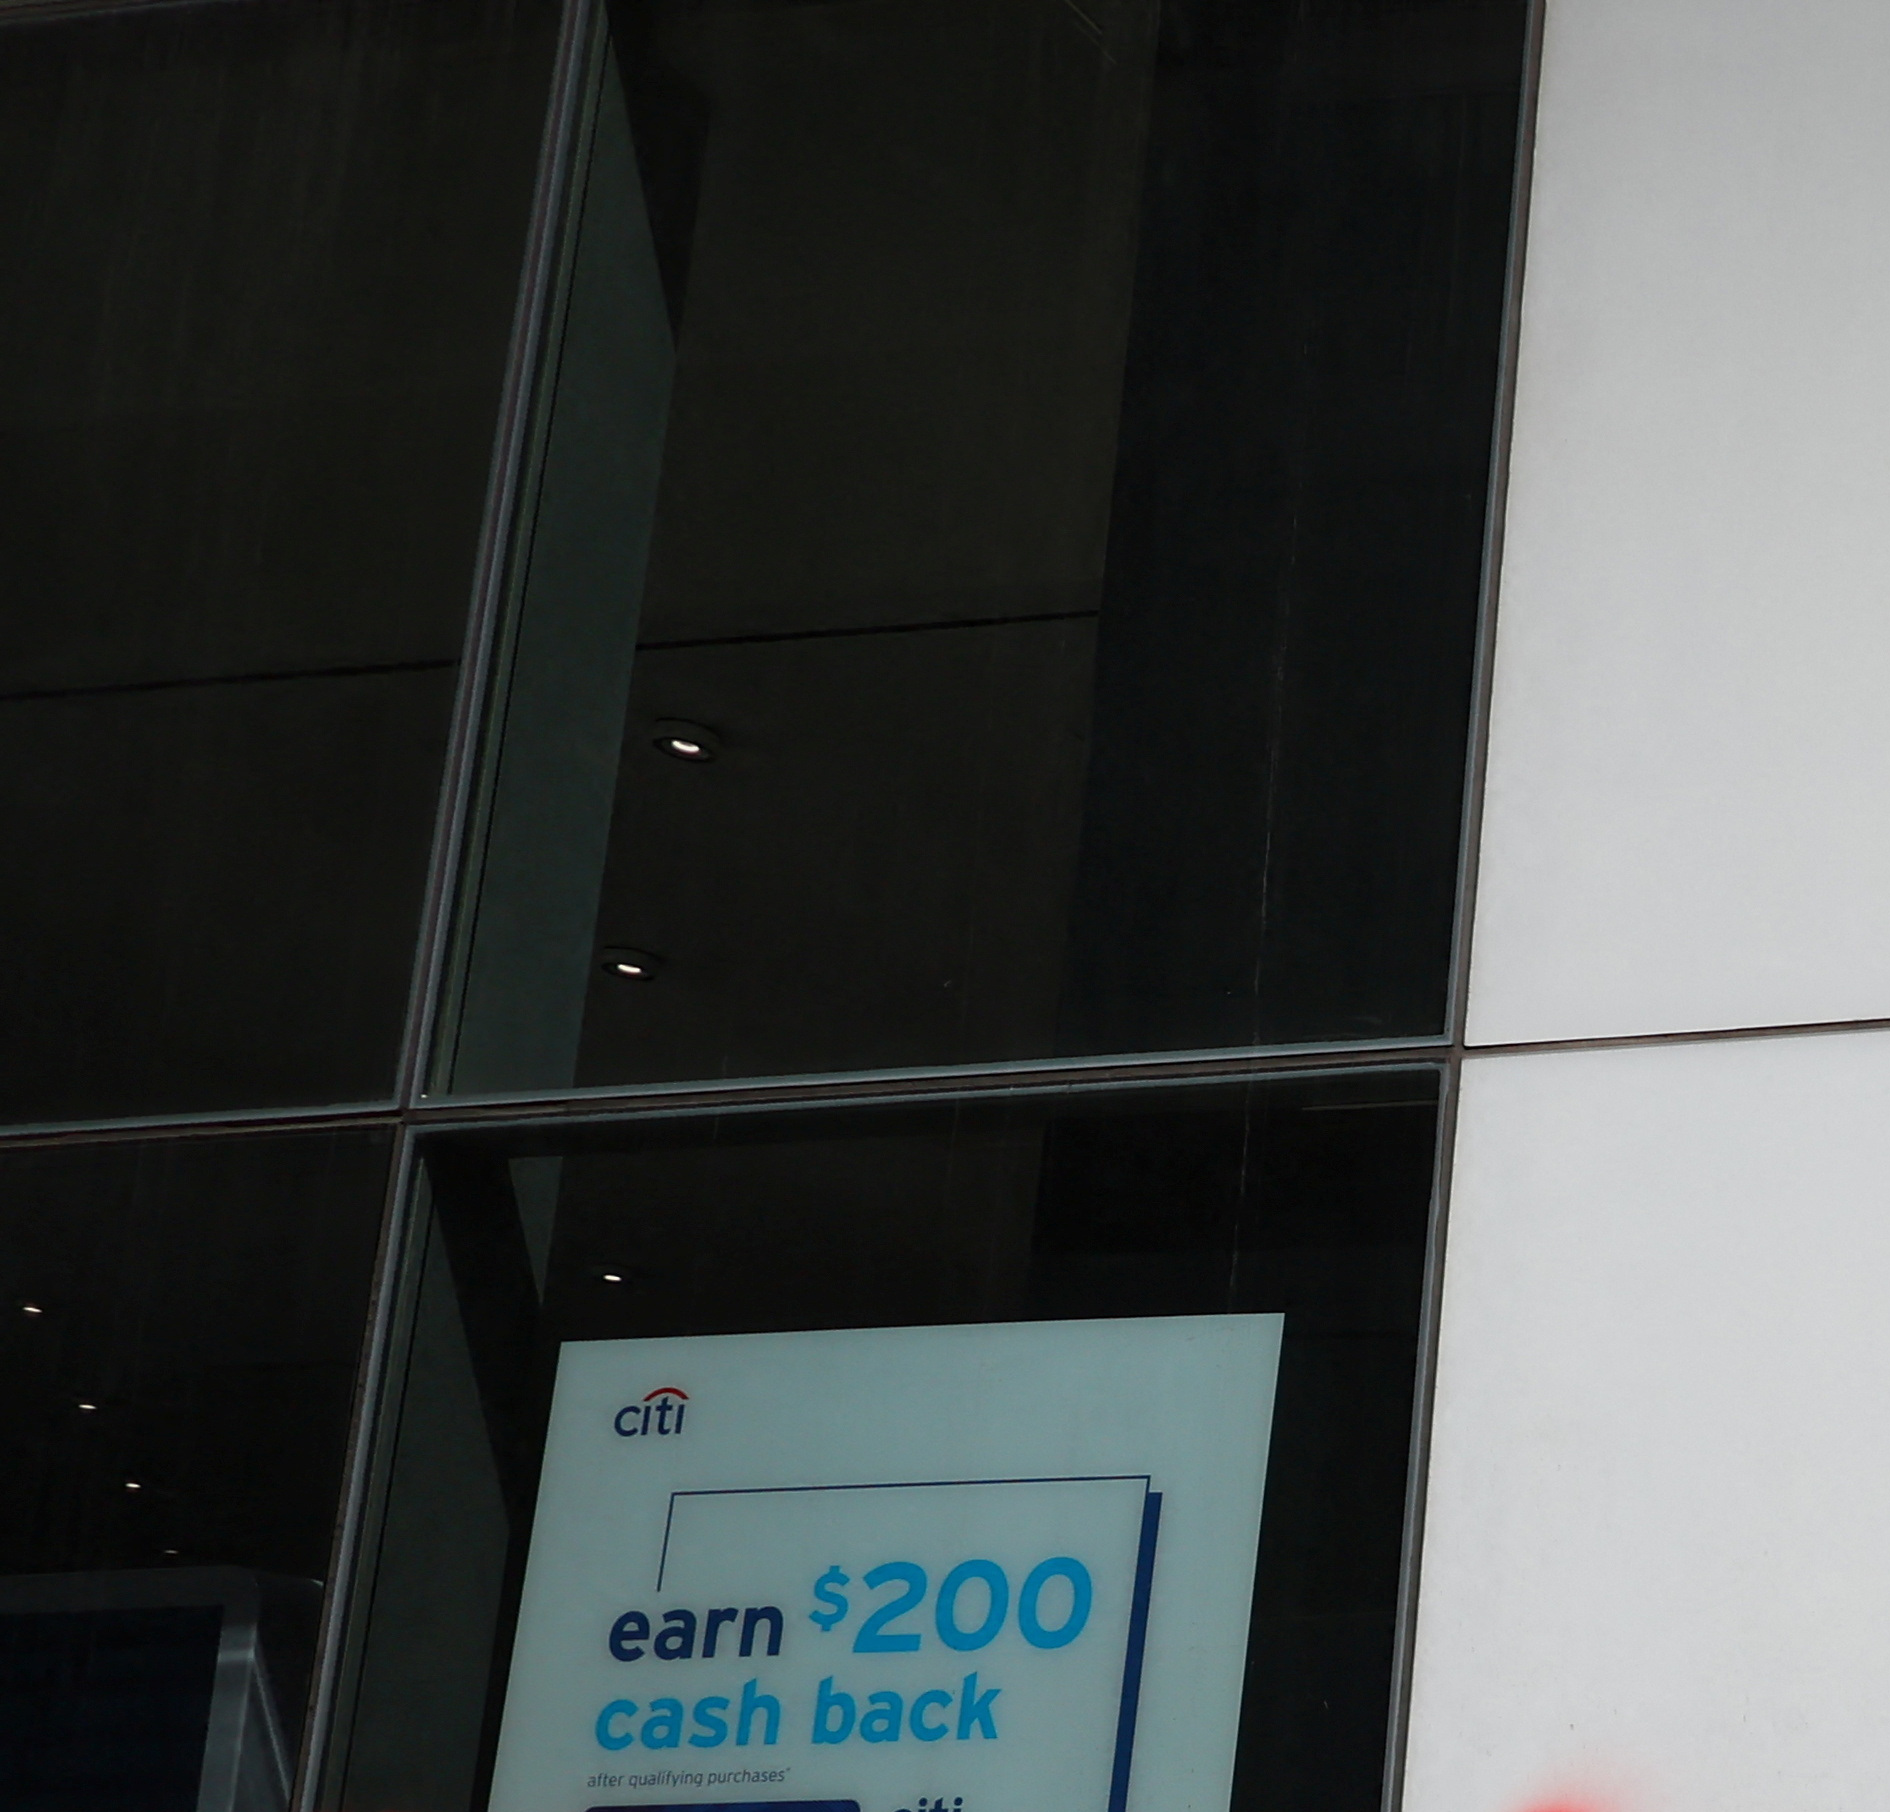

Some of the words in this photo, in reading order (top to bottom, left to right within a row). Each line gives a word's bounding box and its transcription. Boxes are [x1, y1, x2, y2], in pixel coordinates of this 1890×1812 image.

[614, 1395, 685, 1437] citi
[608, 1606, 783, 1661] earn
[809, 1557, 1092, 1654] $200
[595, 1678, 781, 1750] cash
[811, 1671, 1002, 1744] back
[587, 1772, 622, 1788] after
[629, 1770, 703, 1788] qualifying
